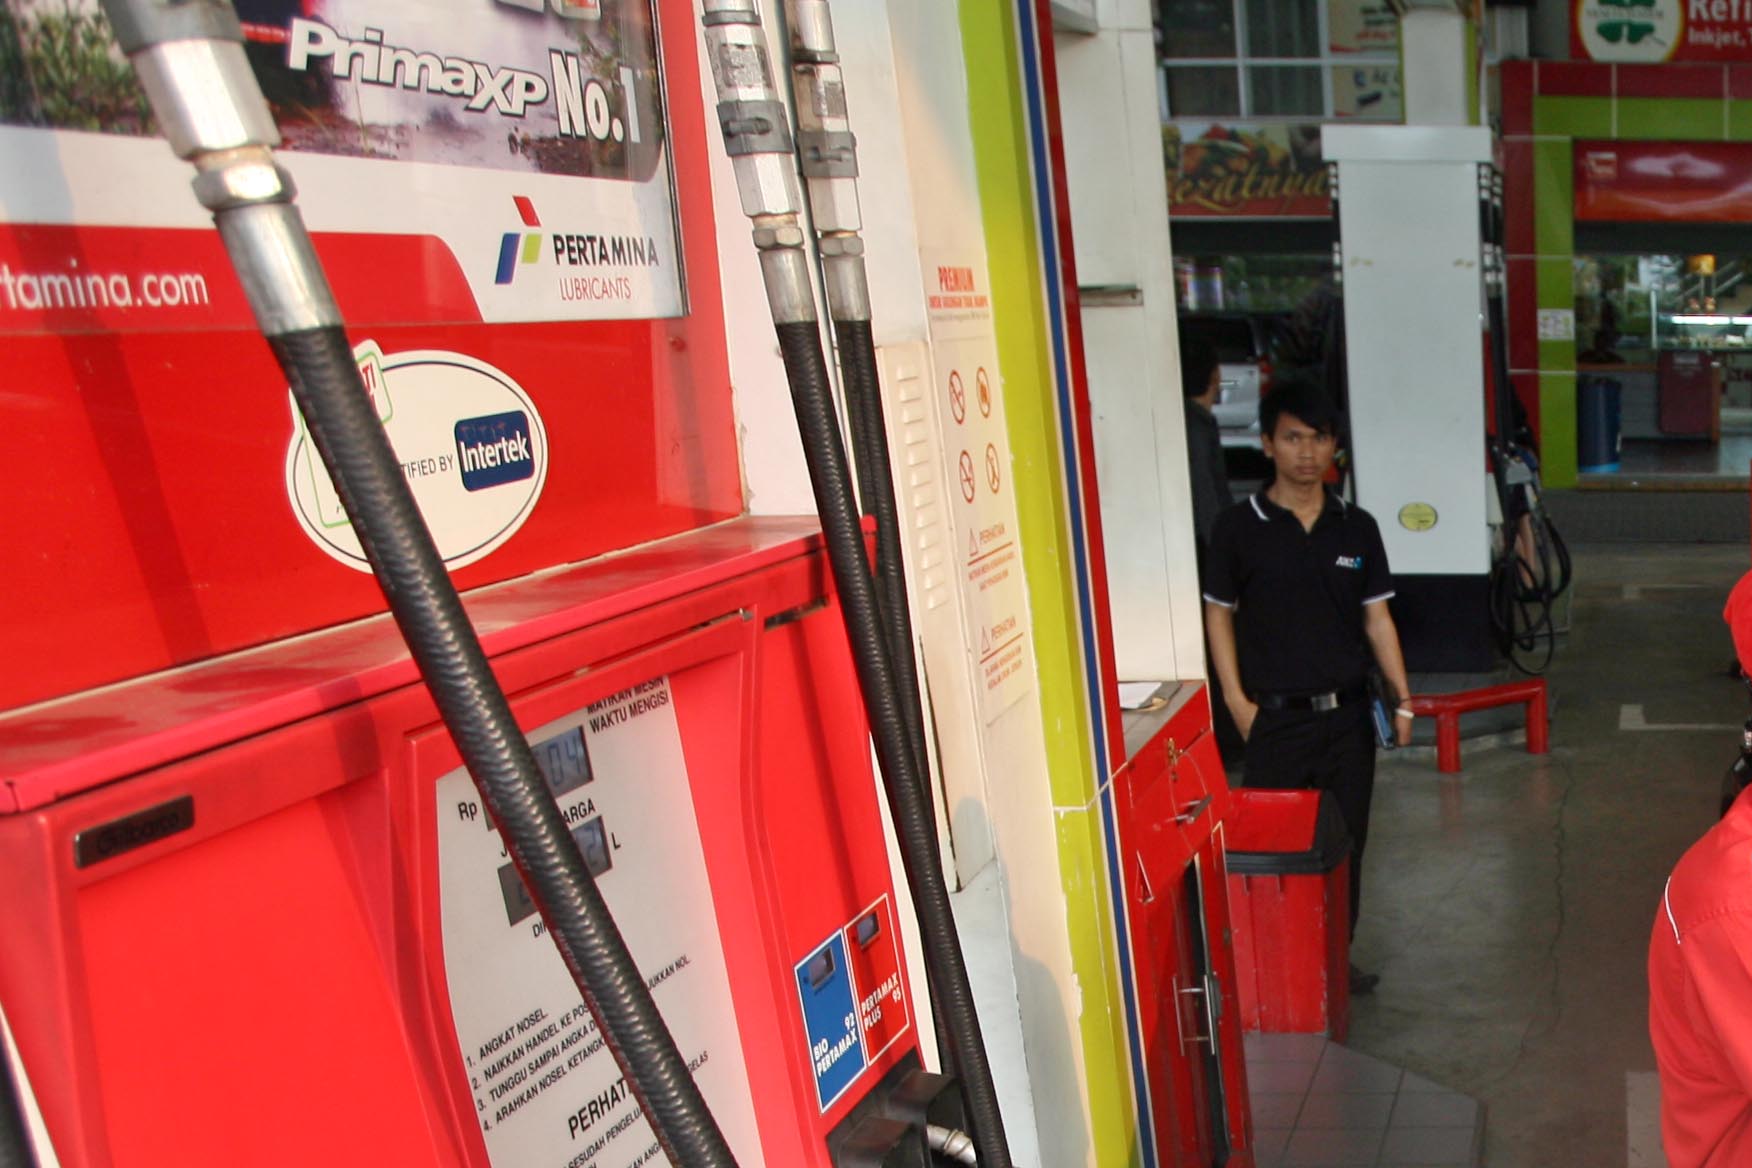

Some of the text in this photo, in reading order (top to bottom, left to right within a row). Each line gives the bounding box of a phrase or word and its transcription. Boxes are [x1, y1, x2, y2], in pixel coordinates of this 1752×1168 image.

[552, 233, 660, 267] PERTAMINA
[559, 277, 632, 301] LUBRICANTS
[400, 453, 455, 482] TIFIED BY
[461, 429, 531, 473] Intertek
[589, 691, 670, 734] WAKTU MENGISI
[458, 801, 478, 828] Rp
[563, 798, 597, 825] ARGA
[611, 832, 621, 850] L
[860, 971, 899, 1017] PERTAMAX
[892, 989, 902, 1004] 95
[844, 1012, 856, 1031] 92
[863, 1008, 882, 1032] PLUS
[479, 1029, 517, 1062] ANGKAT
[483, 1046, 526, 1082] NAIKKAN
[525, 1023, 560, 1058] HANDEL
[560, 1014, 574, 1030] KE
[813, 1037, 829, 1062] BIO
[816, 1026, 859, 1078] PERTAMAX
[489, 1069, 529, 1103] TUNGGU
[528, 1047, 561, 1076] SAMPAI
[560, 1025, 591, 1051] ANGKA
[495, 1086, 539, 1124] ARAHKAN
[539, 1064, 567, 1092] NOSEL
[567, 1038, 605, 1070] KETANGK
[567, 1077, 632, 1141] PERHAT
[605, 1107, 642, 1143] PENGELU
